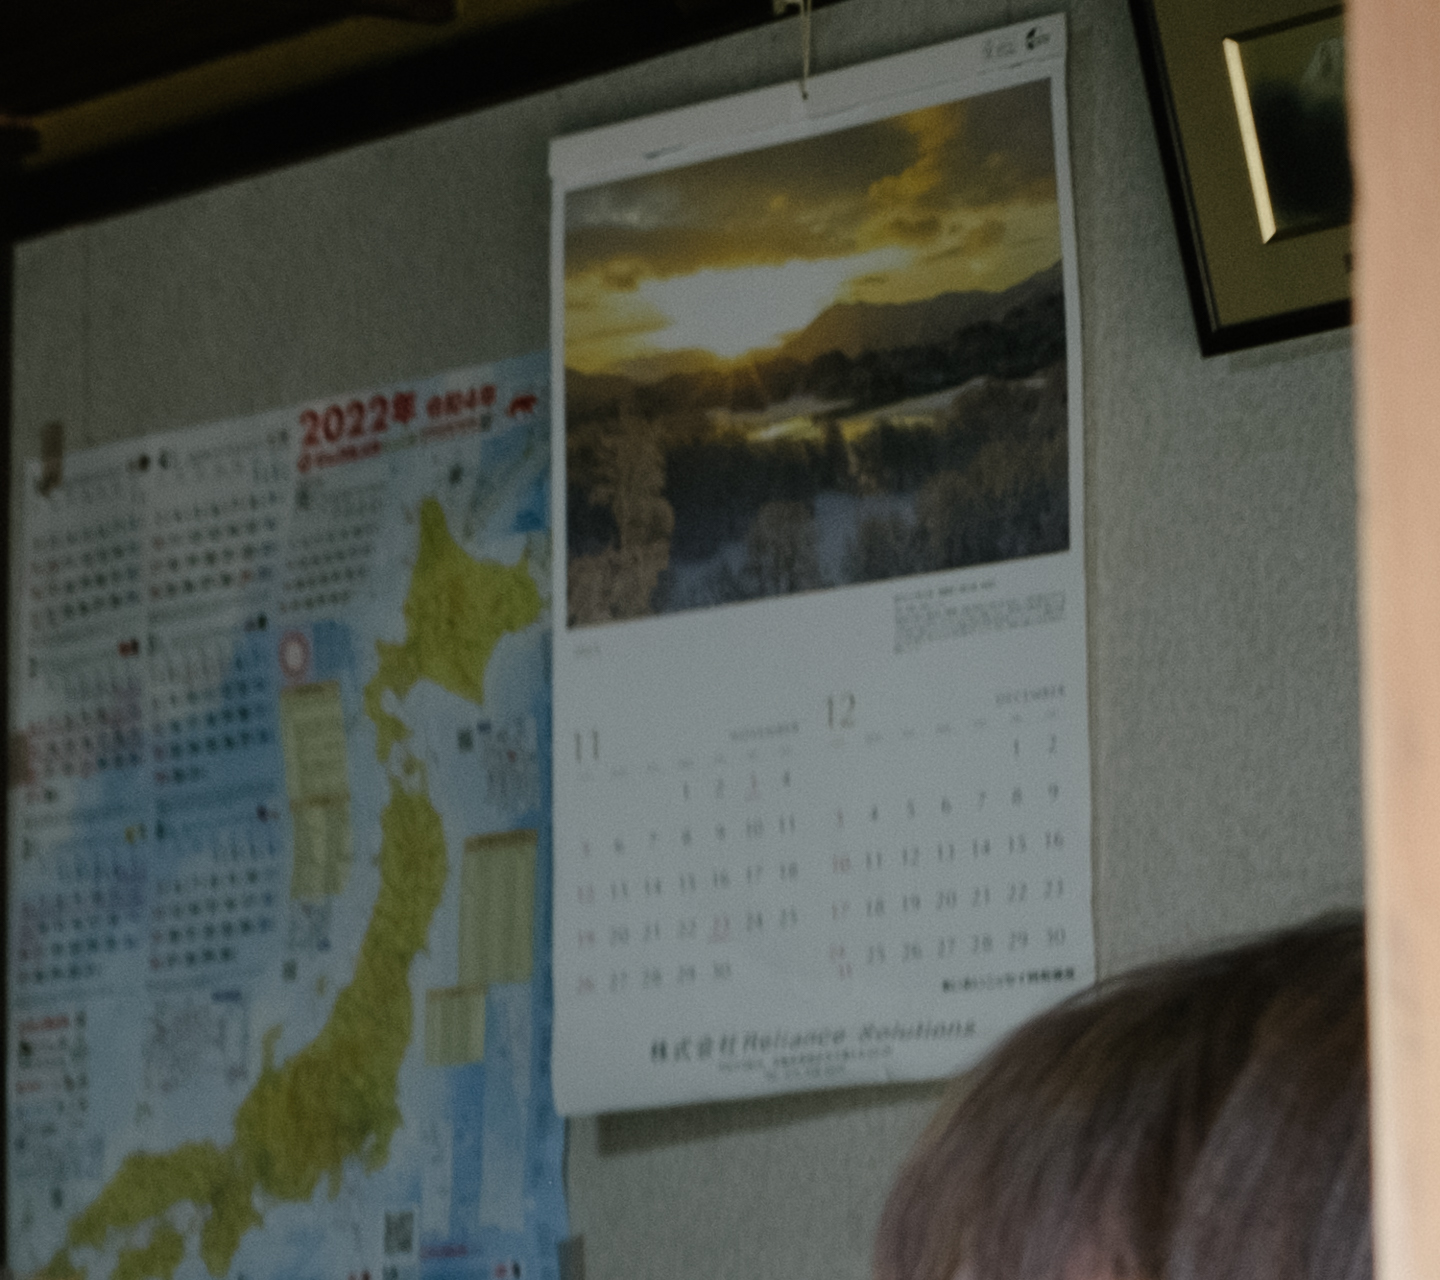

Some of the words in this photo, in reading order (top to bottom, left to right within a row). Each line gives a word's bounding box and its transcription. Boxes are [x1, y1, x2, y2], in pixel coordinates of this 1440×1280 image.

[826, 693, 856, 727] 12
[574, 729, 599, 762] 11
[741, 1026, 847, 1055] Reliance
[857, 1018, 977, 1047] Solutions
